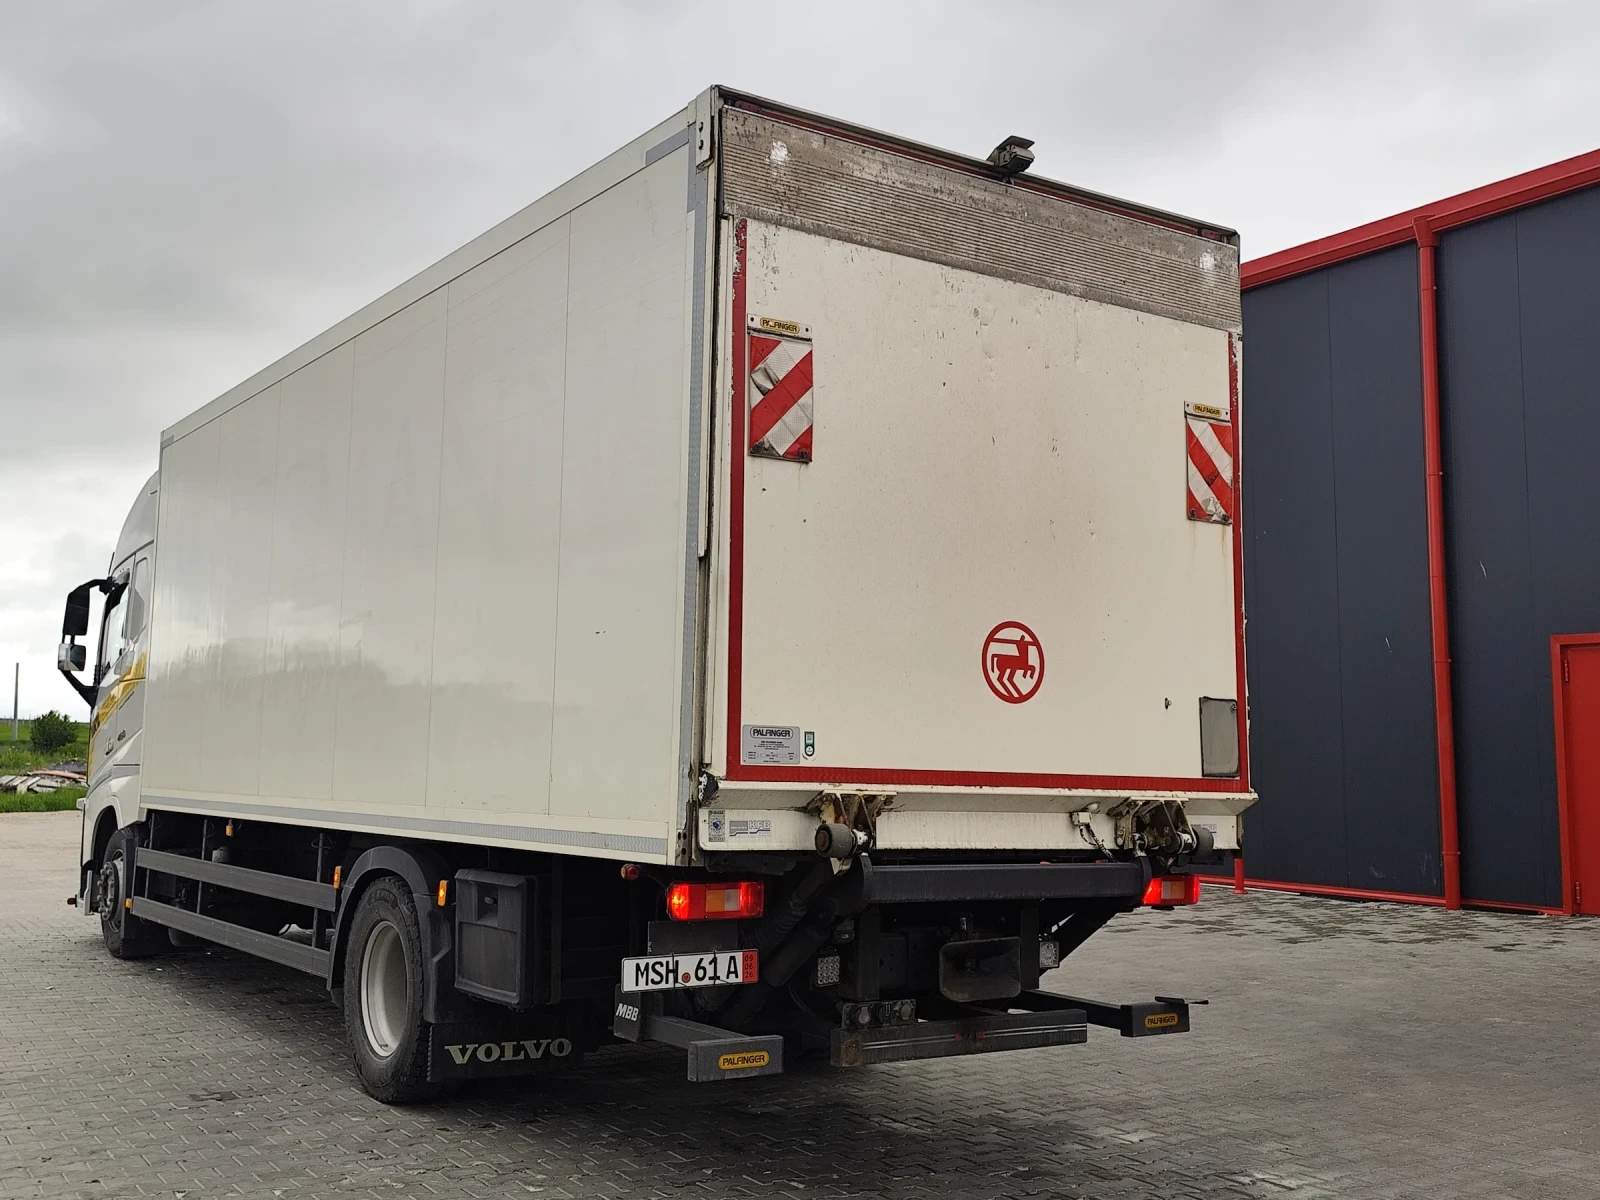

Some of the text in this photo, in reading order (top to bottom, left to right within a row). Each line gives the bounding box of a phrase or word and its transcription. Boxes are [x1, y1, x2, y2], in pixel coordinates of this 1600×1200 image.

[1194, 405, 1221, 415] PALFINGER
[752, 728, 791, 738] PALFINGER
[635, 955, 739, 987] MSH 61 A
[615, 1002, 639, 1022] MBB
[1147, 1015, 1176, 1026] PALFINGER
[444, 1037, 572, 1065] VOLVO
[722, 1054, 766, 1067] PALFINGER
